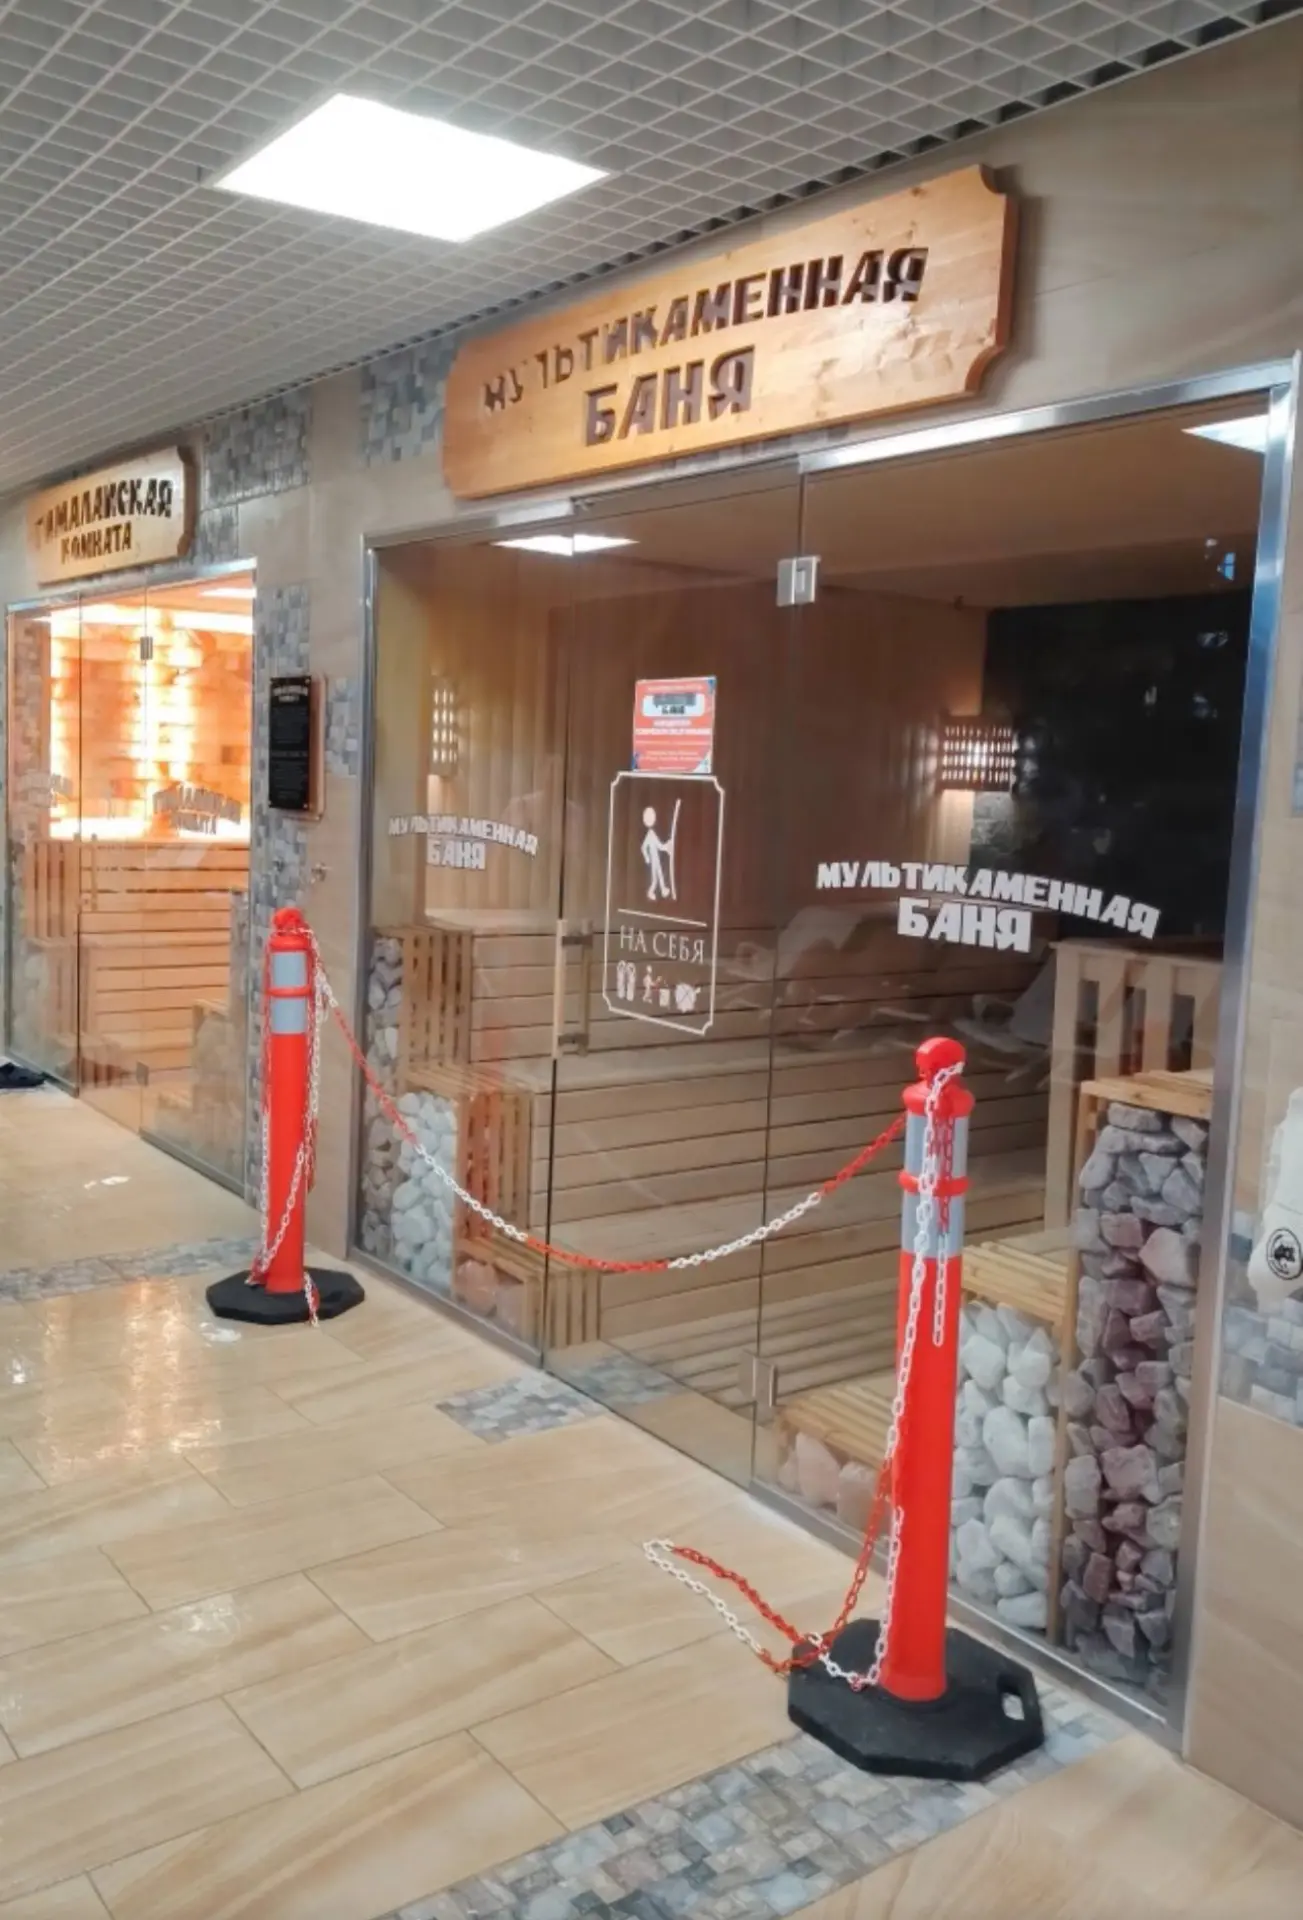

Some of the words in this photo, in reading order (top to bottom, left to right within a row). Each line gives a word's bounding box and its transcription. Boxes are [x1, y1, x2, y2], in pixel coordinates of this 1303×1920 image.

[584, 345, 756, 447] БАНЯ
[60, 521, 132, 564] КОМНАТА
[388, 814, 539, 857] МУЛЬТИКАМЕННАЯ
[425, 839, 487, 870] БАНЯ
[816, 860, 1162, 940] МУЛЬТИКАМЕННАЯ
[619, 925, 648, 954] НА
[652, 931, 705, 965] СЕБЯ
[897, 896, 1033, 953] БАНЯ
